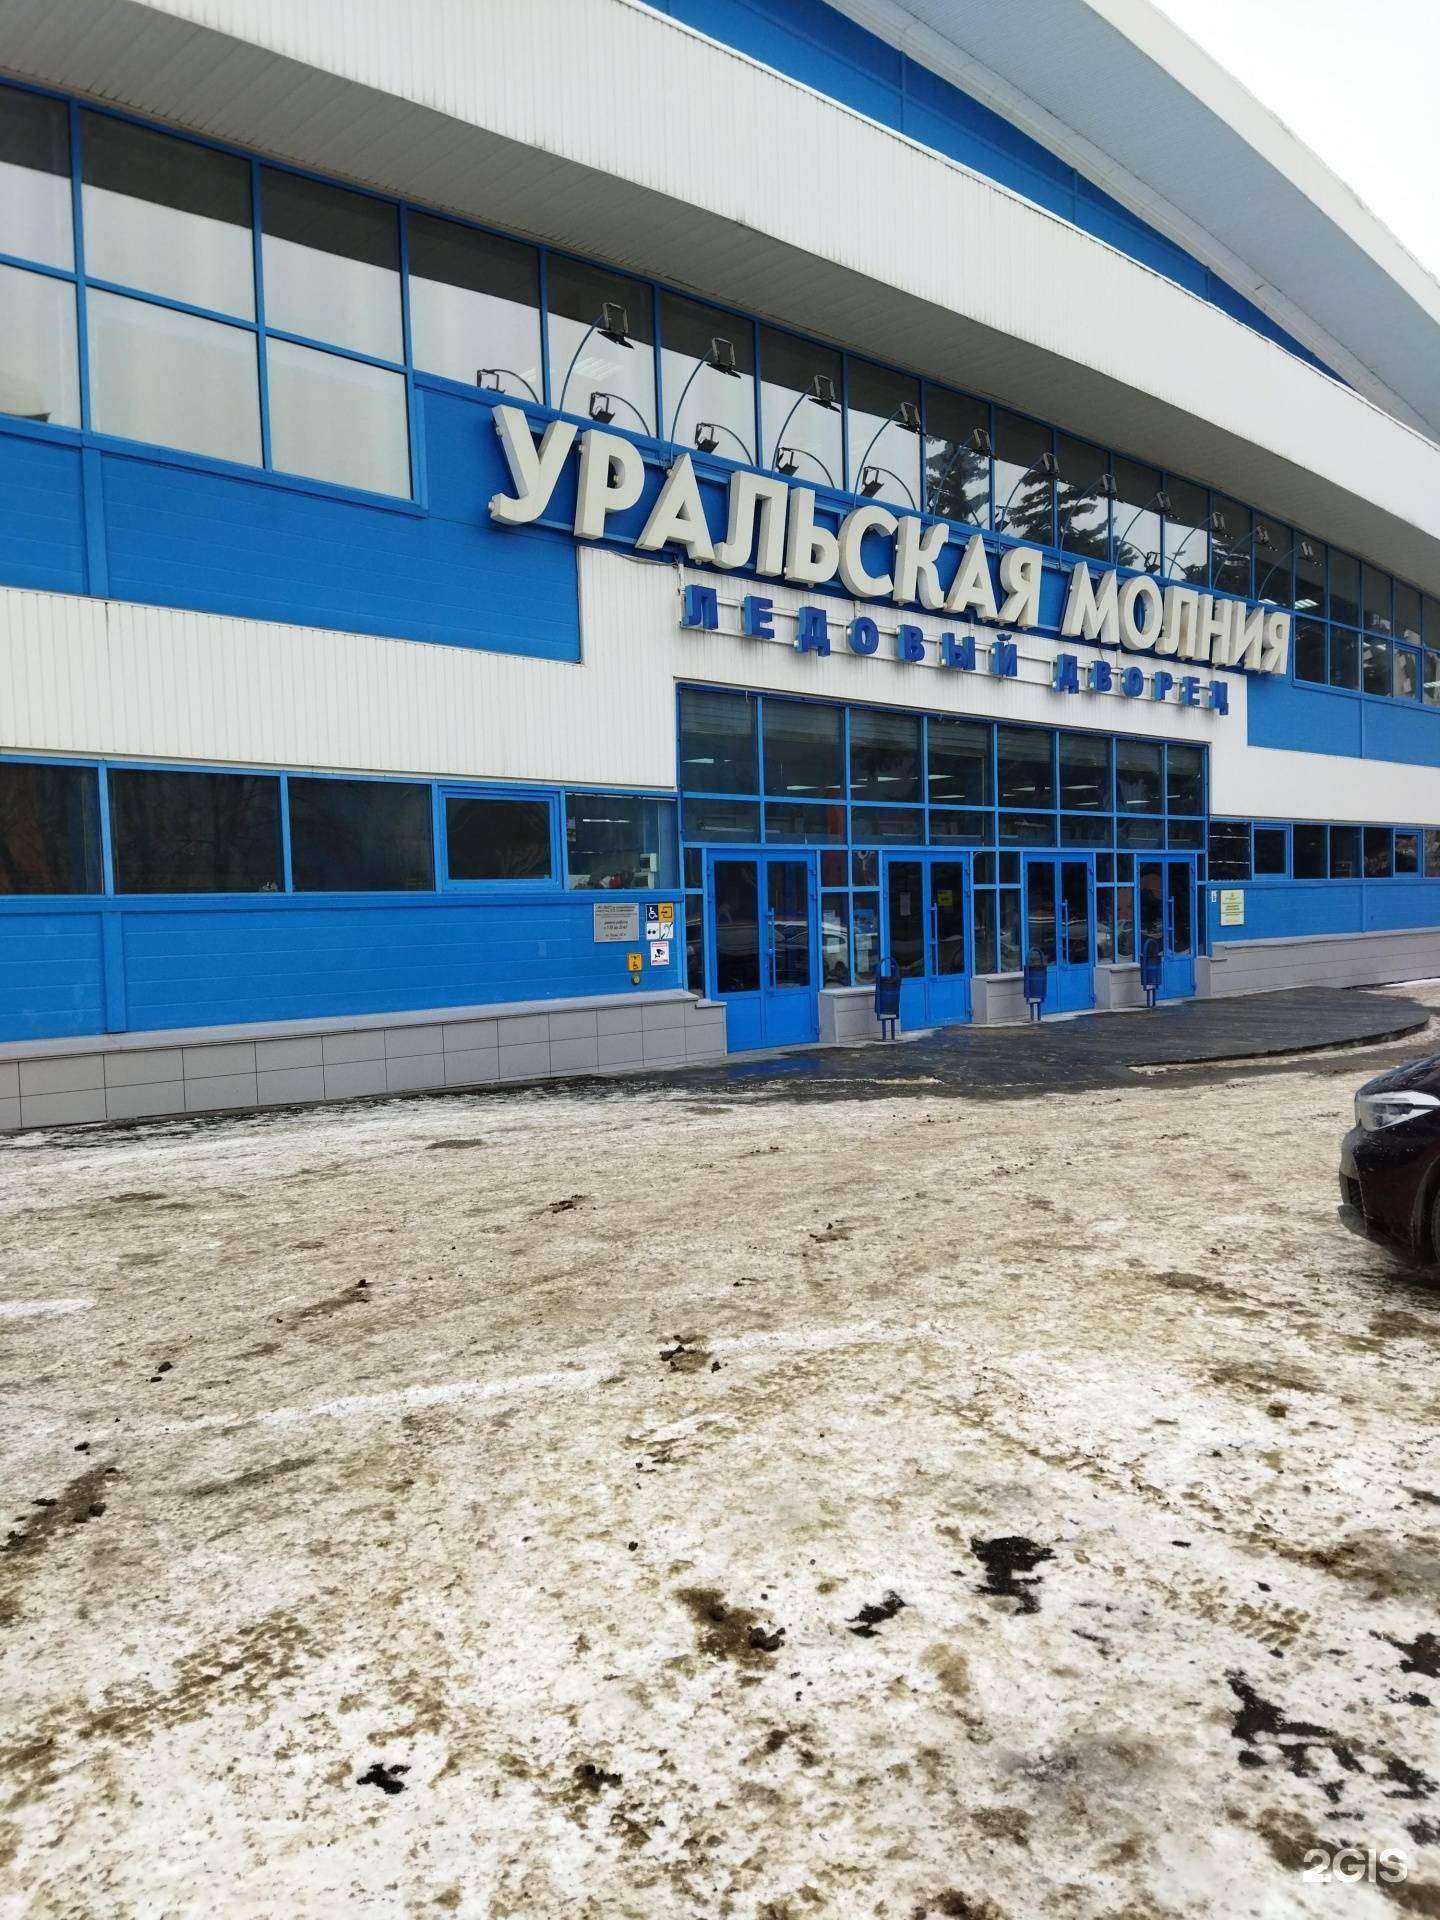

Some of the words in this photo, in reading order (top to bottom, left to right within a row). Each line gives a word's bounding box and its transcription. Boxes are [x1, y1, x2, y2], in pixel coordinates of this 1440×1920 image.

[490, 404, 1043, 628] УРАЛЬСКАЯ
[1062, 561, 1291, 676] МОЛНИЯ
[683, 585, 1018, 678] ЛЕДОВЫЙ
[1054, 653, 1229, 716] ДВОРЕЦ
